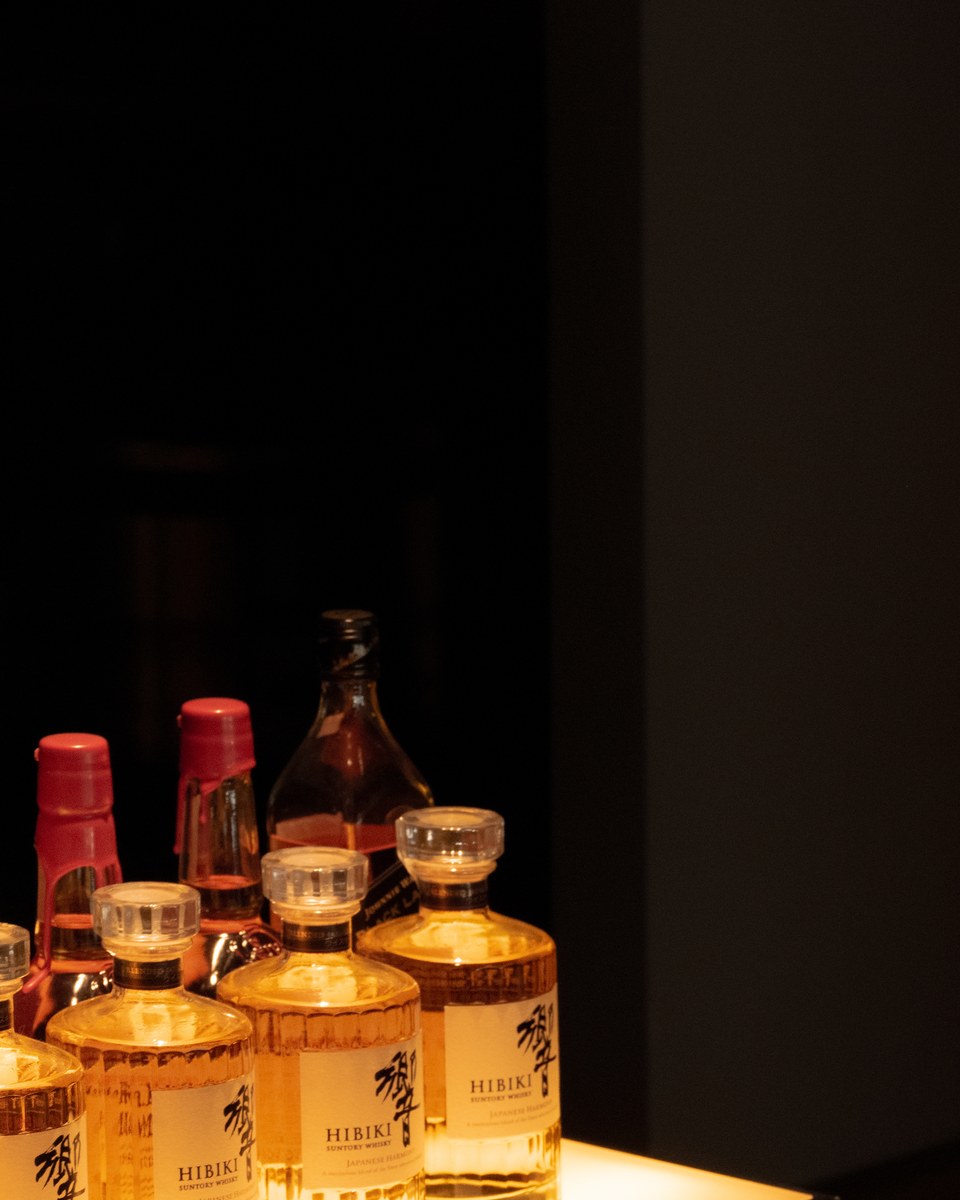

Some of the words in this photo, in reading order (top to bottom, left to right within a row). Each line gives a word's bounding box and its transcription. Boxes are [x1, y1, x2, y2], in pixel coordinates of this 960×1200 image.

[470, 1074, 532, 1094] HIBIKI
[326, 1122, 392, 1142] HIBIKI
[326, 1144, 363, 1152] SUNTORY
[178, 1158, 238, 1182] HIBIKI
[179, 1182, 214, 1192] SUNTORY
